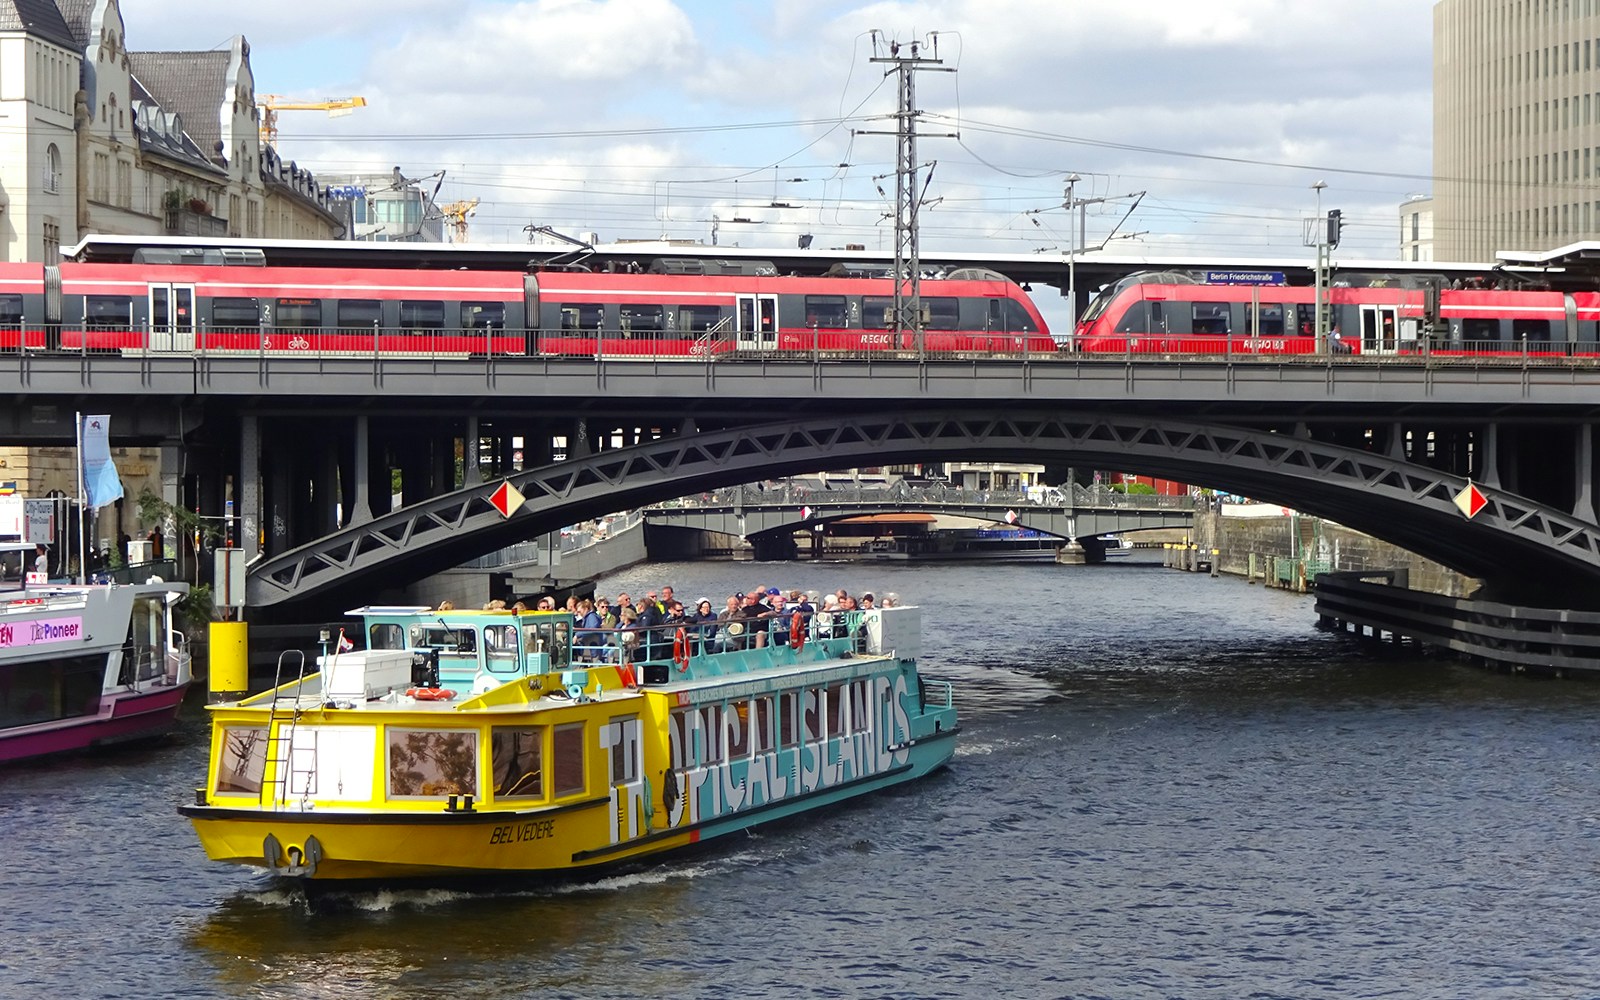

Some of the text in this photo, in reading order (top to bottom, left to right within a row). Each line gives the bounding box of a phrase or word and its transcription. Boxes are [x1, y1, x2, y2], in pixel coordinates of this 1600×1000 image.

[1229, 273, 1273, 281] Friedrichstraße
[264, 305, 270, 315] 2
[851, 302, 857, 311] 2
[668, 312, 674, 321] 2
[1287, 310, 1293, 319] 2
[1453, 324, 1459, 334] 2
[44, 623, 79, 639] Pioneer
[790, 675, 911, 795] ISLANDS
